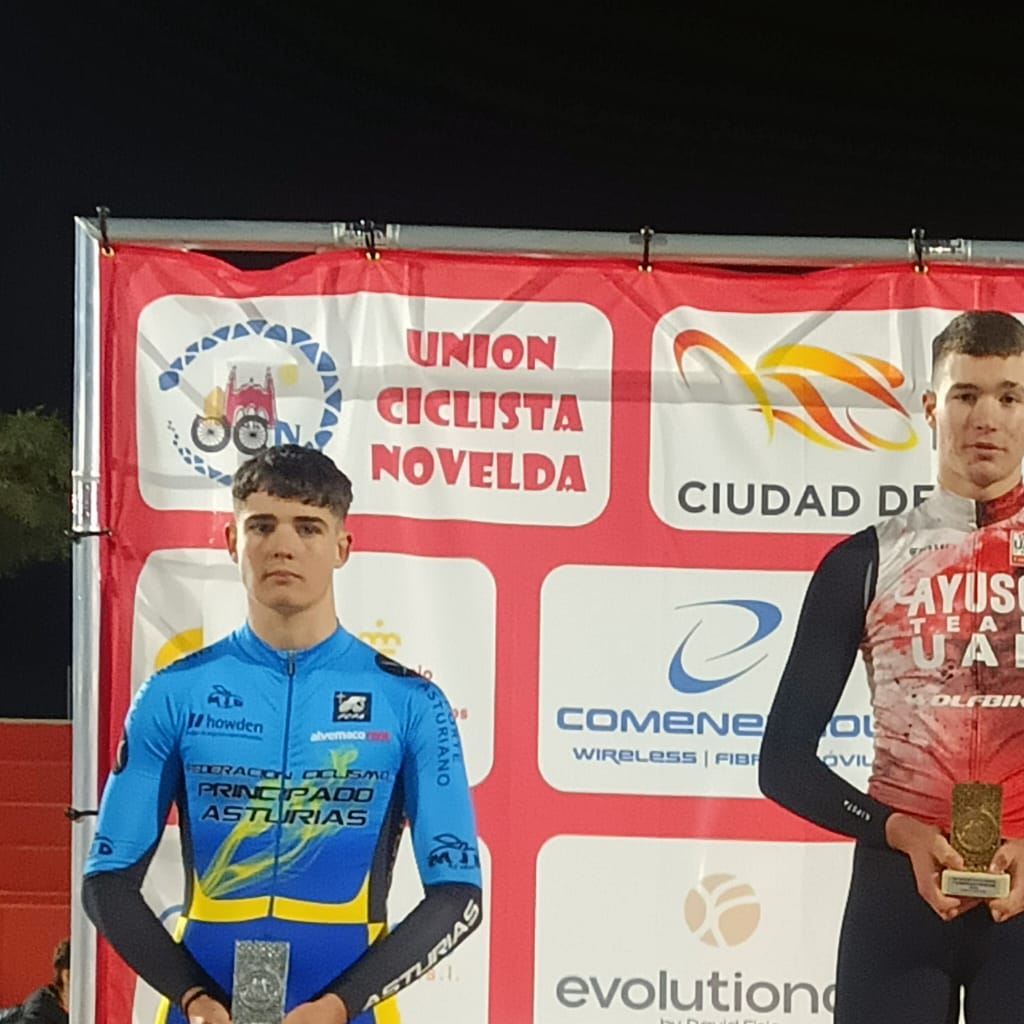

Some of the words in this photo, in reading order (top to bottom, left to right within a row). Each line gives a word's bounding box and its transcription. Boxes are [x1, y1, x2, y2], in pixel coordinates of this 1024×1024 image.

[407, 328, 556, 370] UNION
[377, 387, 583, 431] CICLISTA
[371, 444, 587, 492] NOVELDA
[678, 481, 861, 517] CIUDAD
[879, 484, 934, 517] DE
[206, 715, 263, 734] howden
[416, 681, 451, 787] ASTURIANO
[202, 805, 368, 827] ASTURIAS
[363, 899, 480, 1011] ASTURIAS
